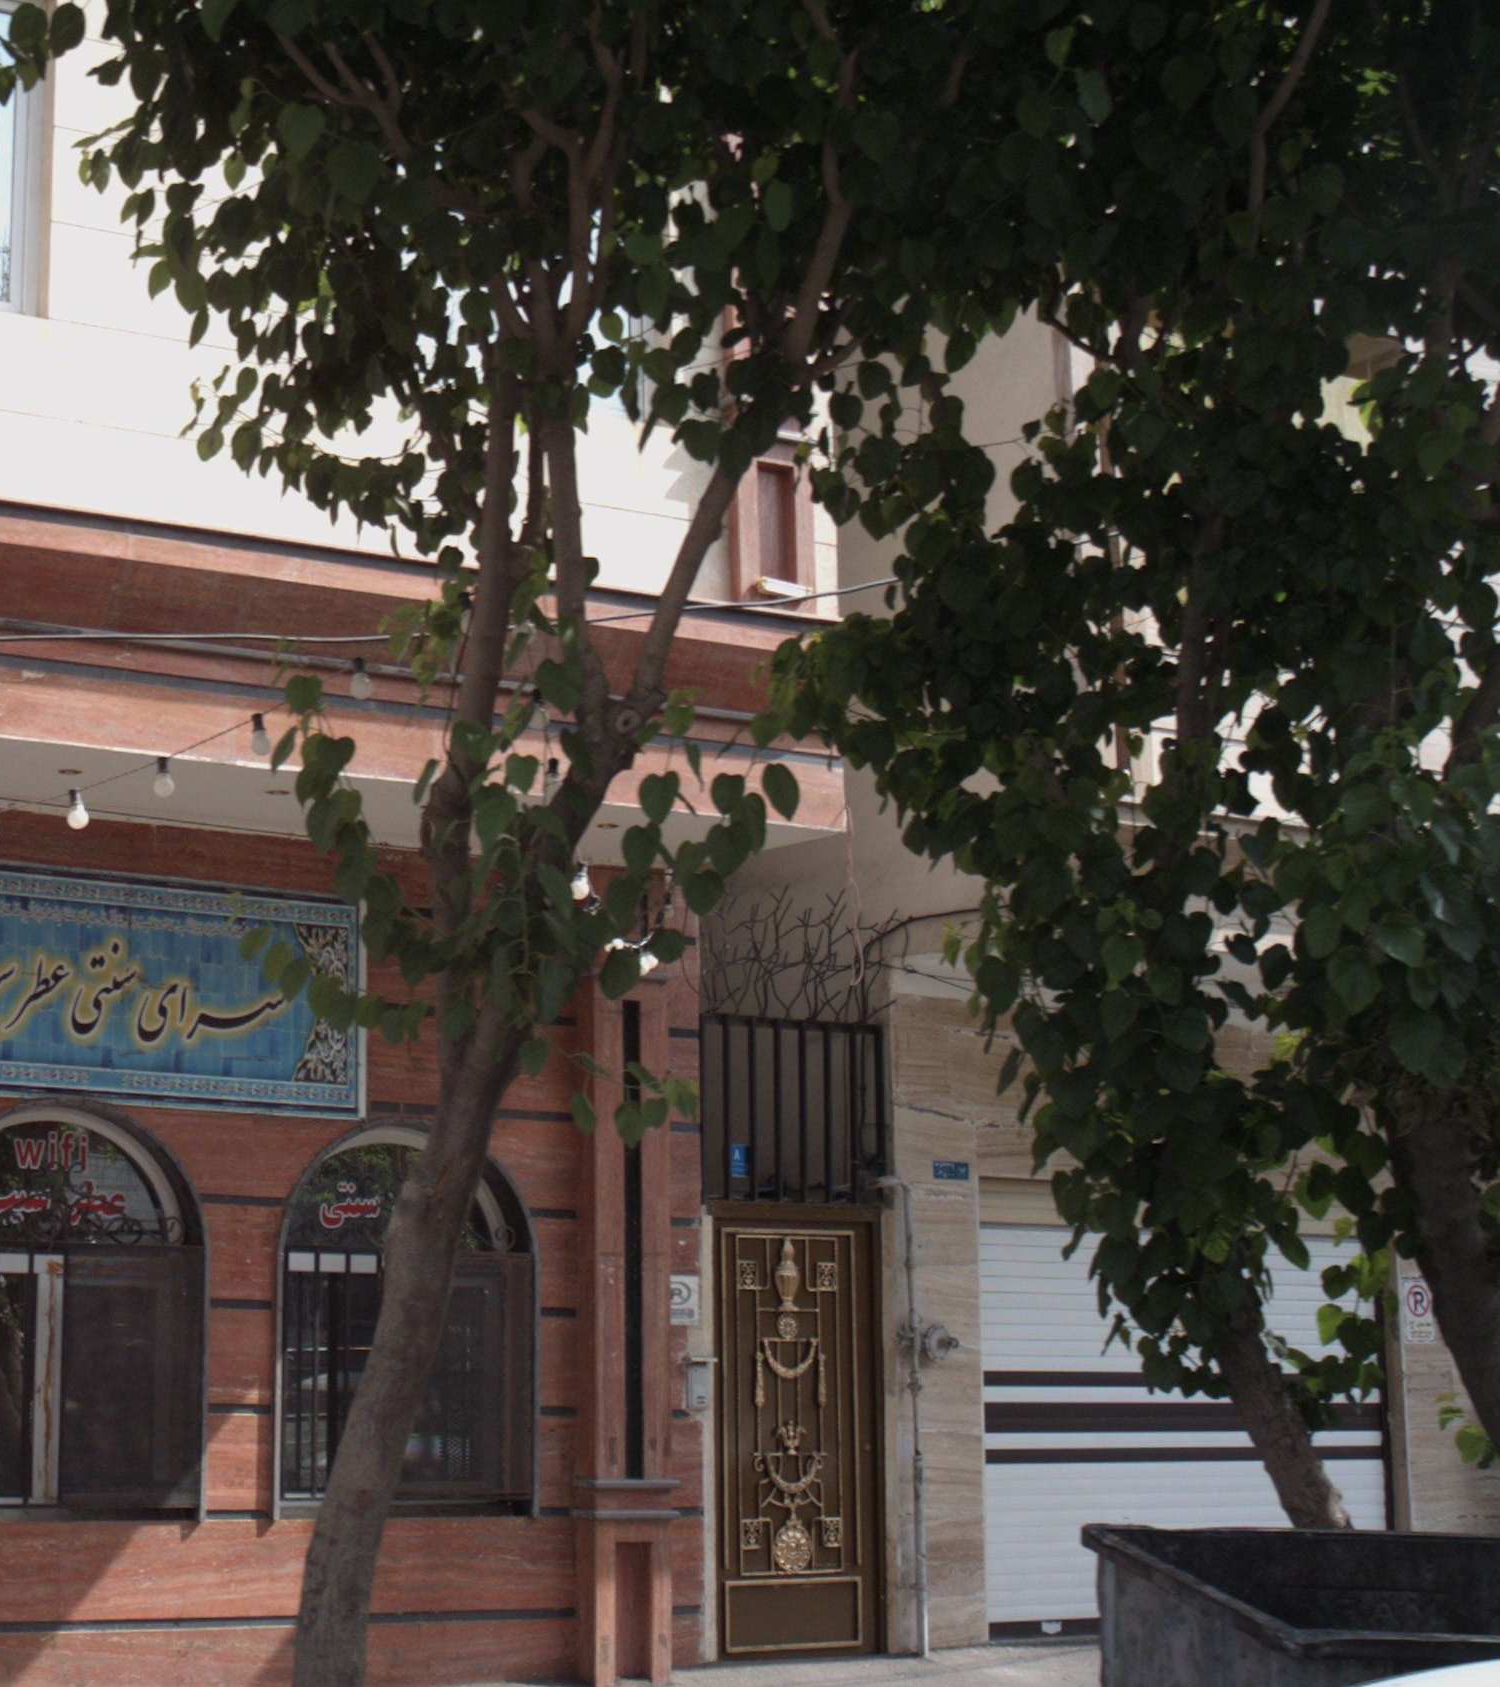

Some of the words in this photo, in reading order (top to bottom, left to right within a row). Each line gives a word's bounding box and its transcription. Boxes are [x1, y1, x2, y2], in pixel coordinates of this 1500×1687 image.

[6, 956, 70, 1029] عطر
[71, 941, 138, 1035] سنتی
[138, 981, 287, 1043] سرای
[13, 1131, 89, 1172] wifi
